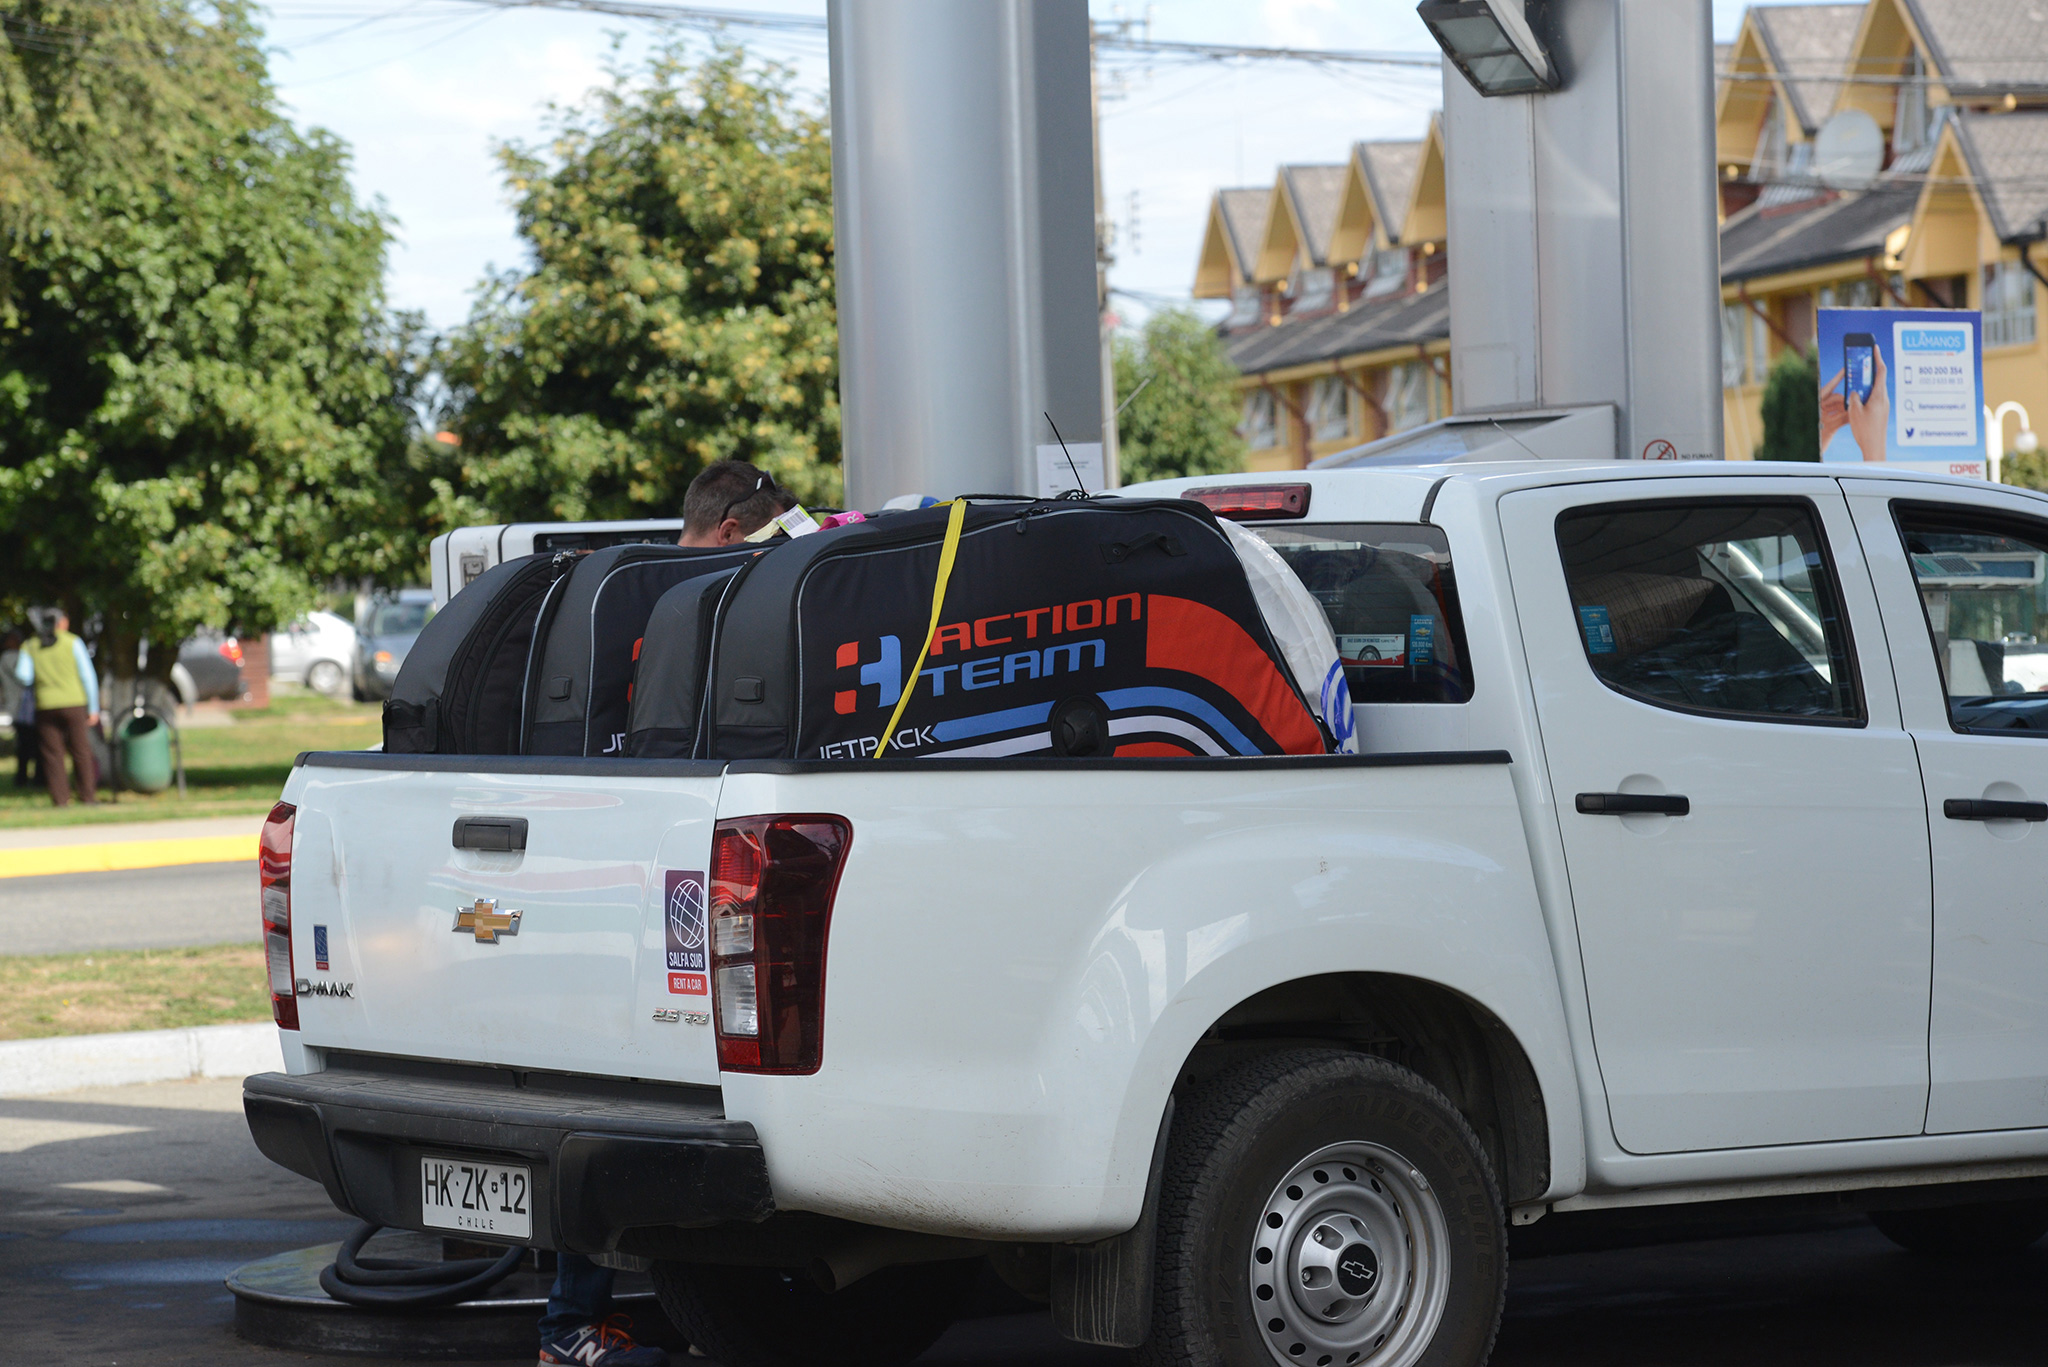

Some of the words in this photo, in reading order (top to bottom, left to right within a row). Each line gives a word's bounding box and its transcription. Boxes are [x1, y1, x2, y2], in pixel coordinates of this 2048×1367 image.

[1934, 366, 1948, 375] 200
[929, 592, 1141, 656] ACTION
[918, 638, 1106, 697] TEAM
[669, 952, 689, 967] SALFA
[690, 953, 704, 968] SUR
[673, 977, 687, 989] RENT
[687, 979, 691, 990] A
[691, 979, 702, 990] CAR
[458, 1215, 494, 1230] CHILE
